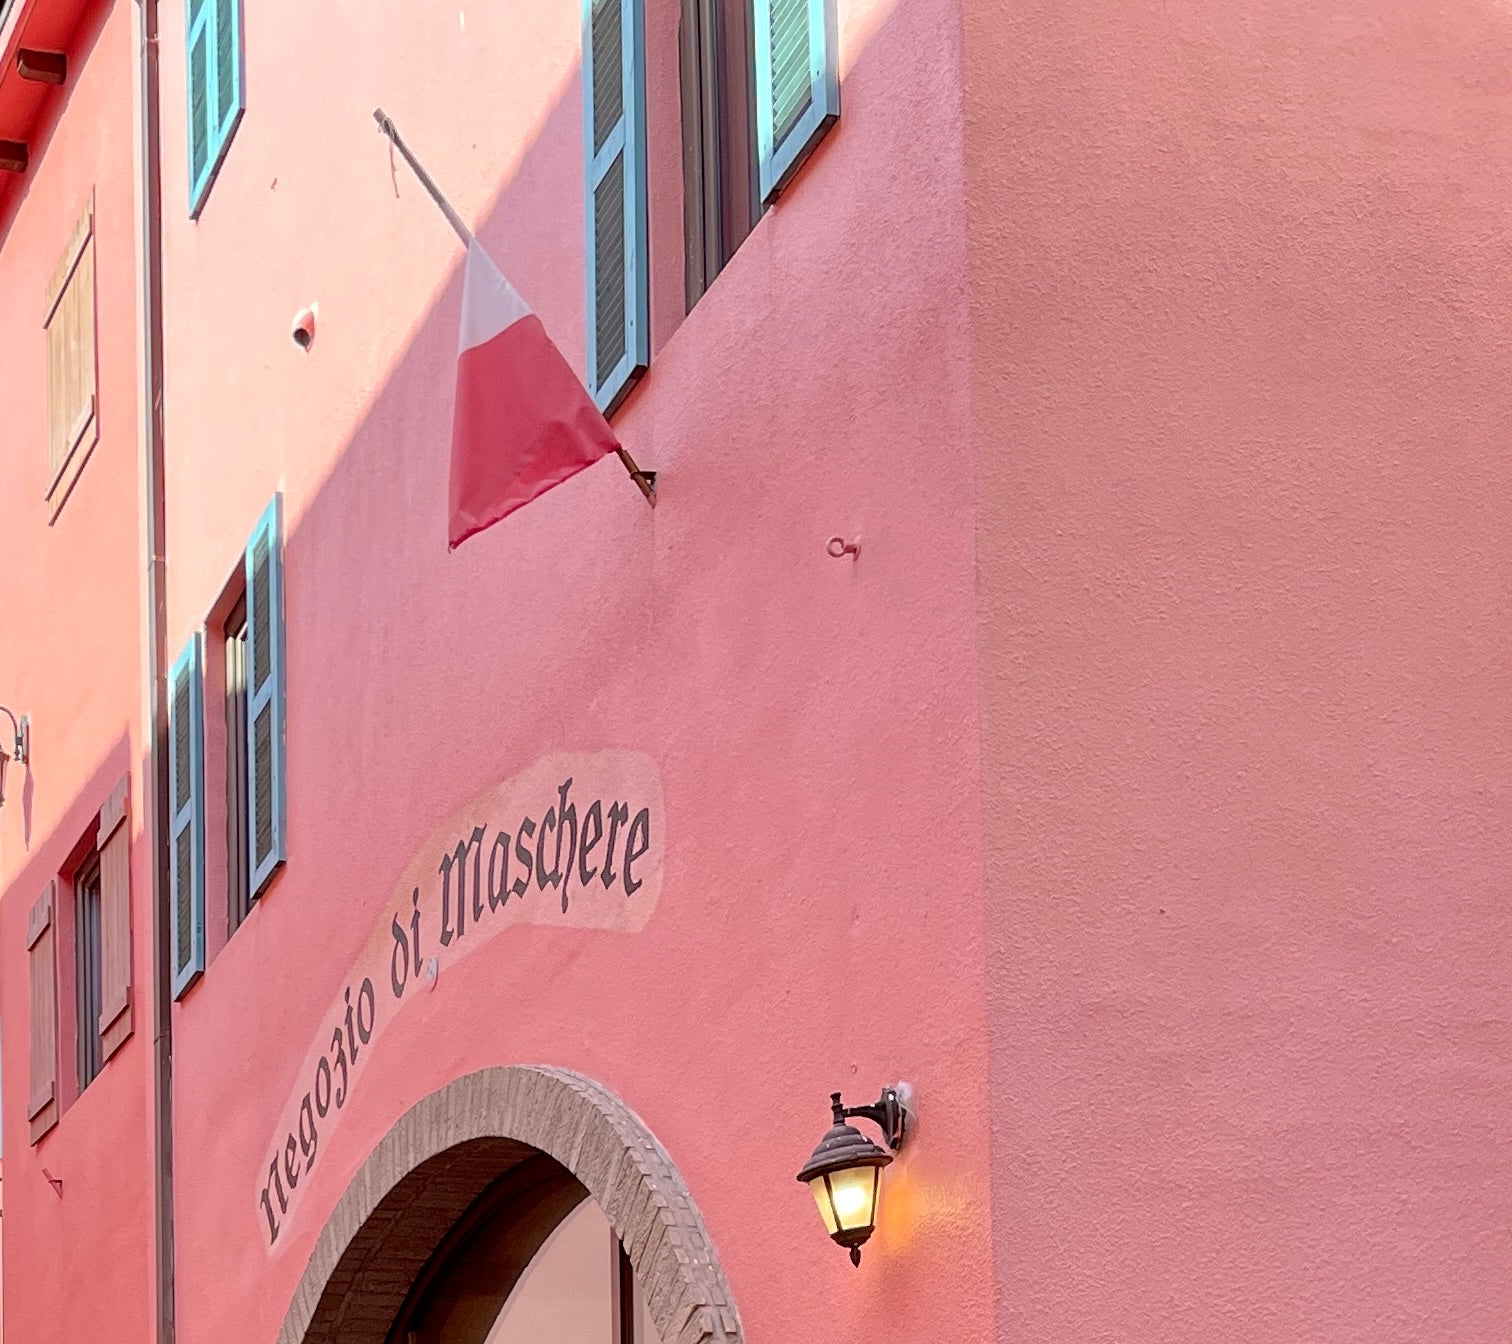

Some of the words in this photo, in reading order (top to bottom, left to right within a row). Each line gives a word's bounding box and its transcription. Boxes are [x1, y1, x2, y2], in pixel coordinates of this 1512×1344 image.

[260, 977, 375, 1245] Negozio
[391, 887, 423, 998] di
[439, 777, 650, 947] Maschere
